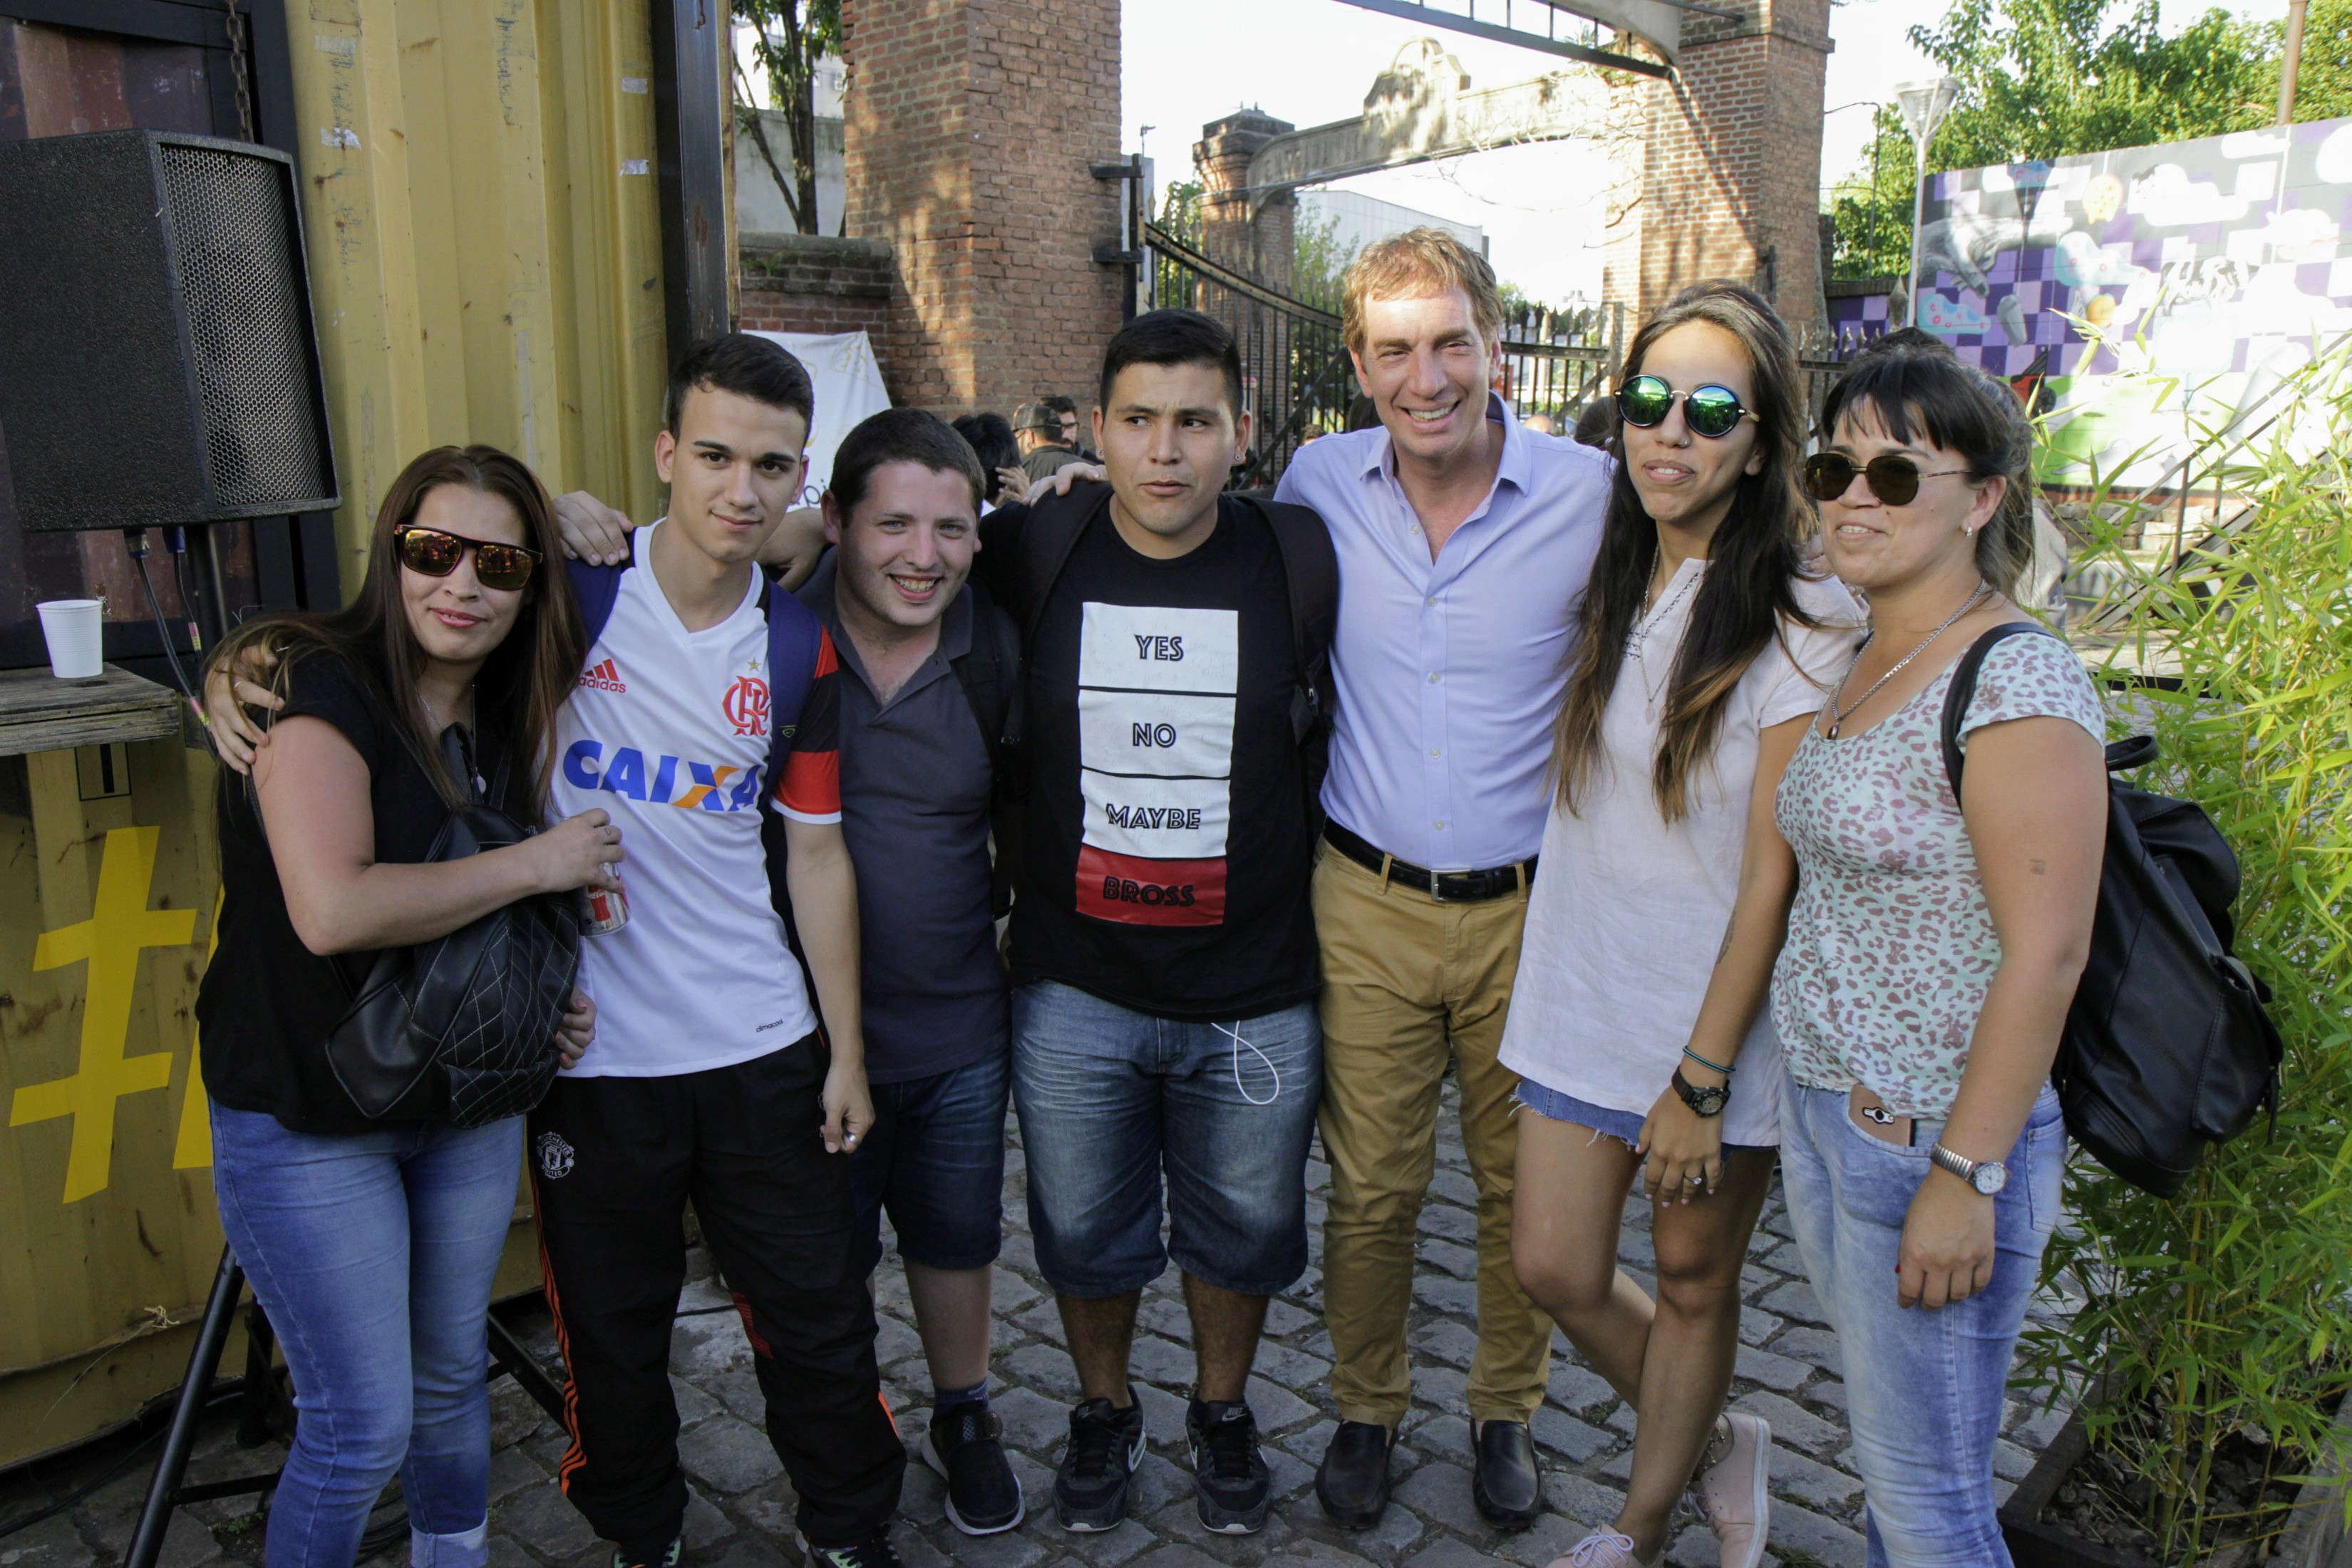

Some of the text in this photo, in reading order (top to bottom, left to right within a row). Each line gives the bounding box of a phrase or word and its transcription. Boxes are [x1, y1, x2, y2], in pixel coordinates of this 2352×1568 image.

[1134, 634, 1184, 661] YES
[578, 676, 626, 693] adidas
[1133, 723, 1176, 748] NO
[563, 739, 762, 812] CAIXA
[1105, 803, 1201, 830] MAYBE
[1103, 875, 1195, 907] BROSS
[1226, 1407, 1243, 1416] NIKE
